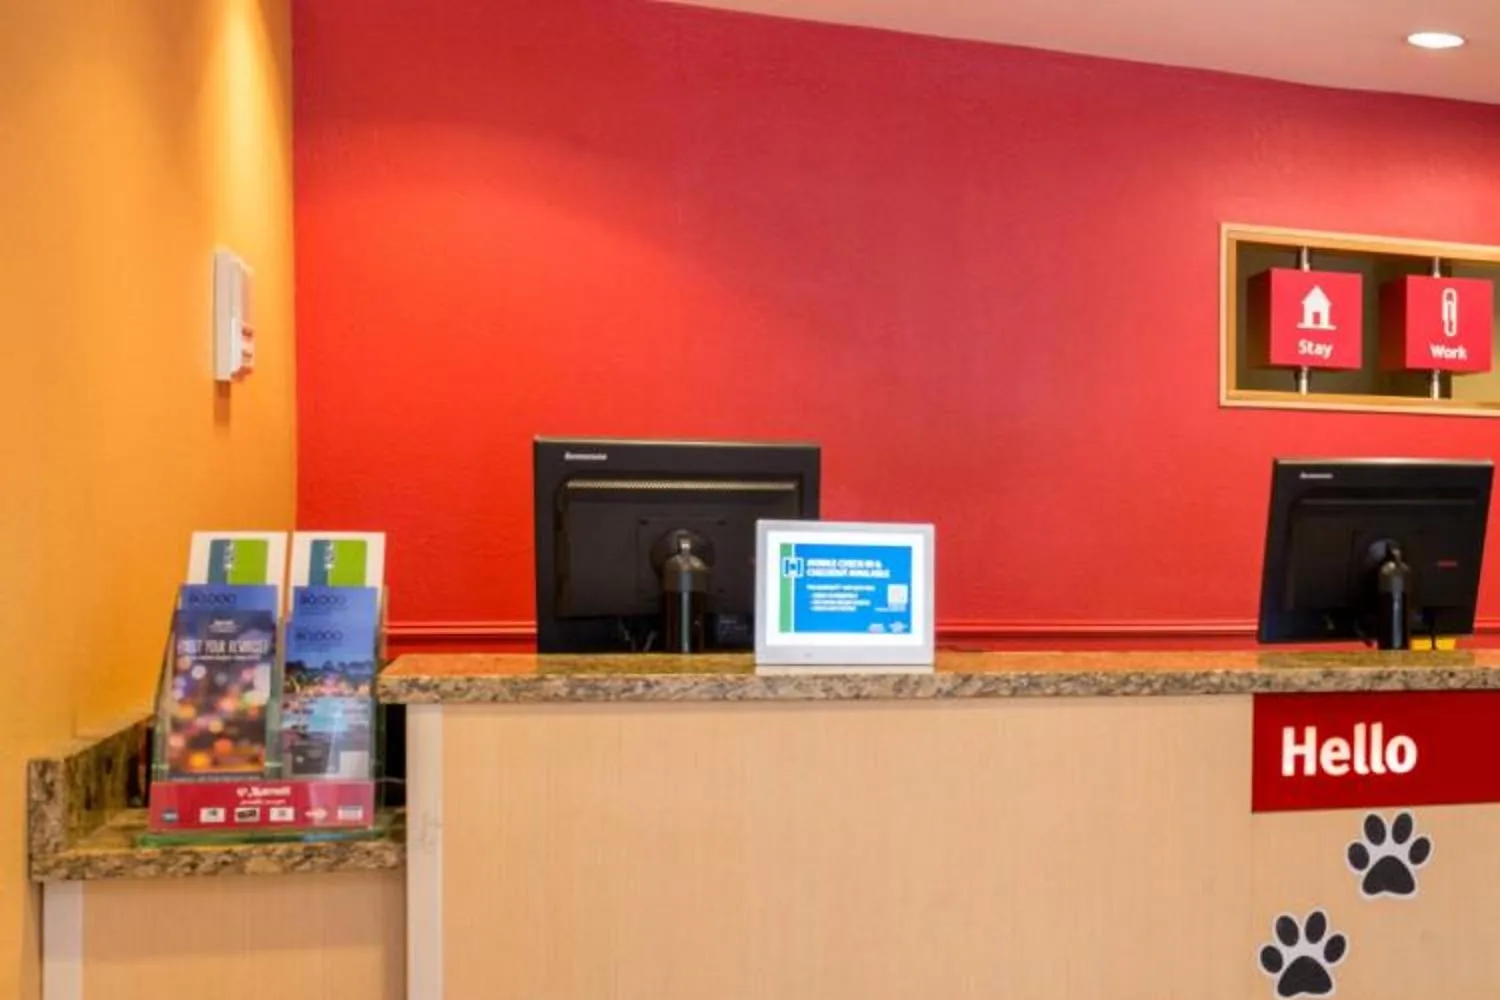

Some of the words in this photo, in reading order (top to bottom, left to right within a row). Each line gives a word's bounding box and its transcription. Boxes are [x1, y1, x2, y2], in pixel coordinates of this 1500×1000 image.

[1298, 339, 1333, 360] Stay
[1430, 344, 1468, 360] Work
[1281, 722, 1418, 776] Hello
